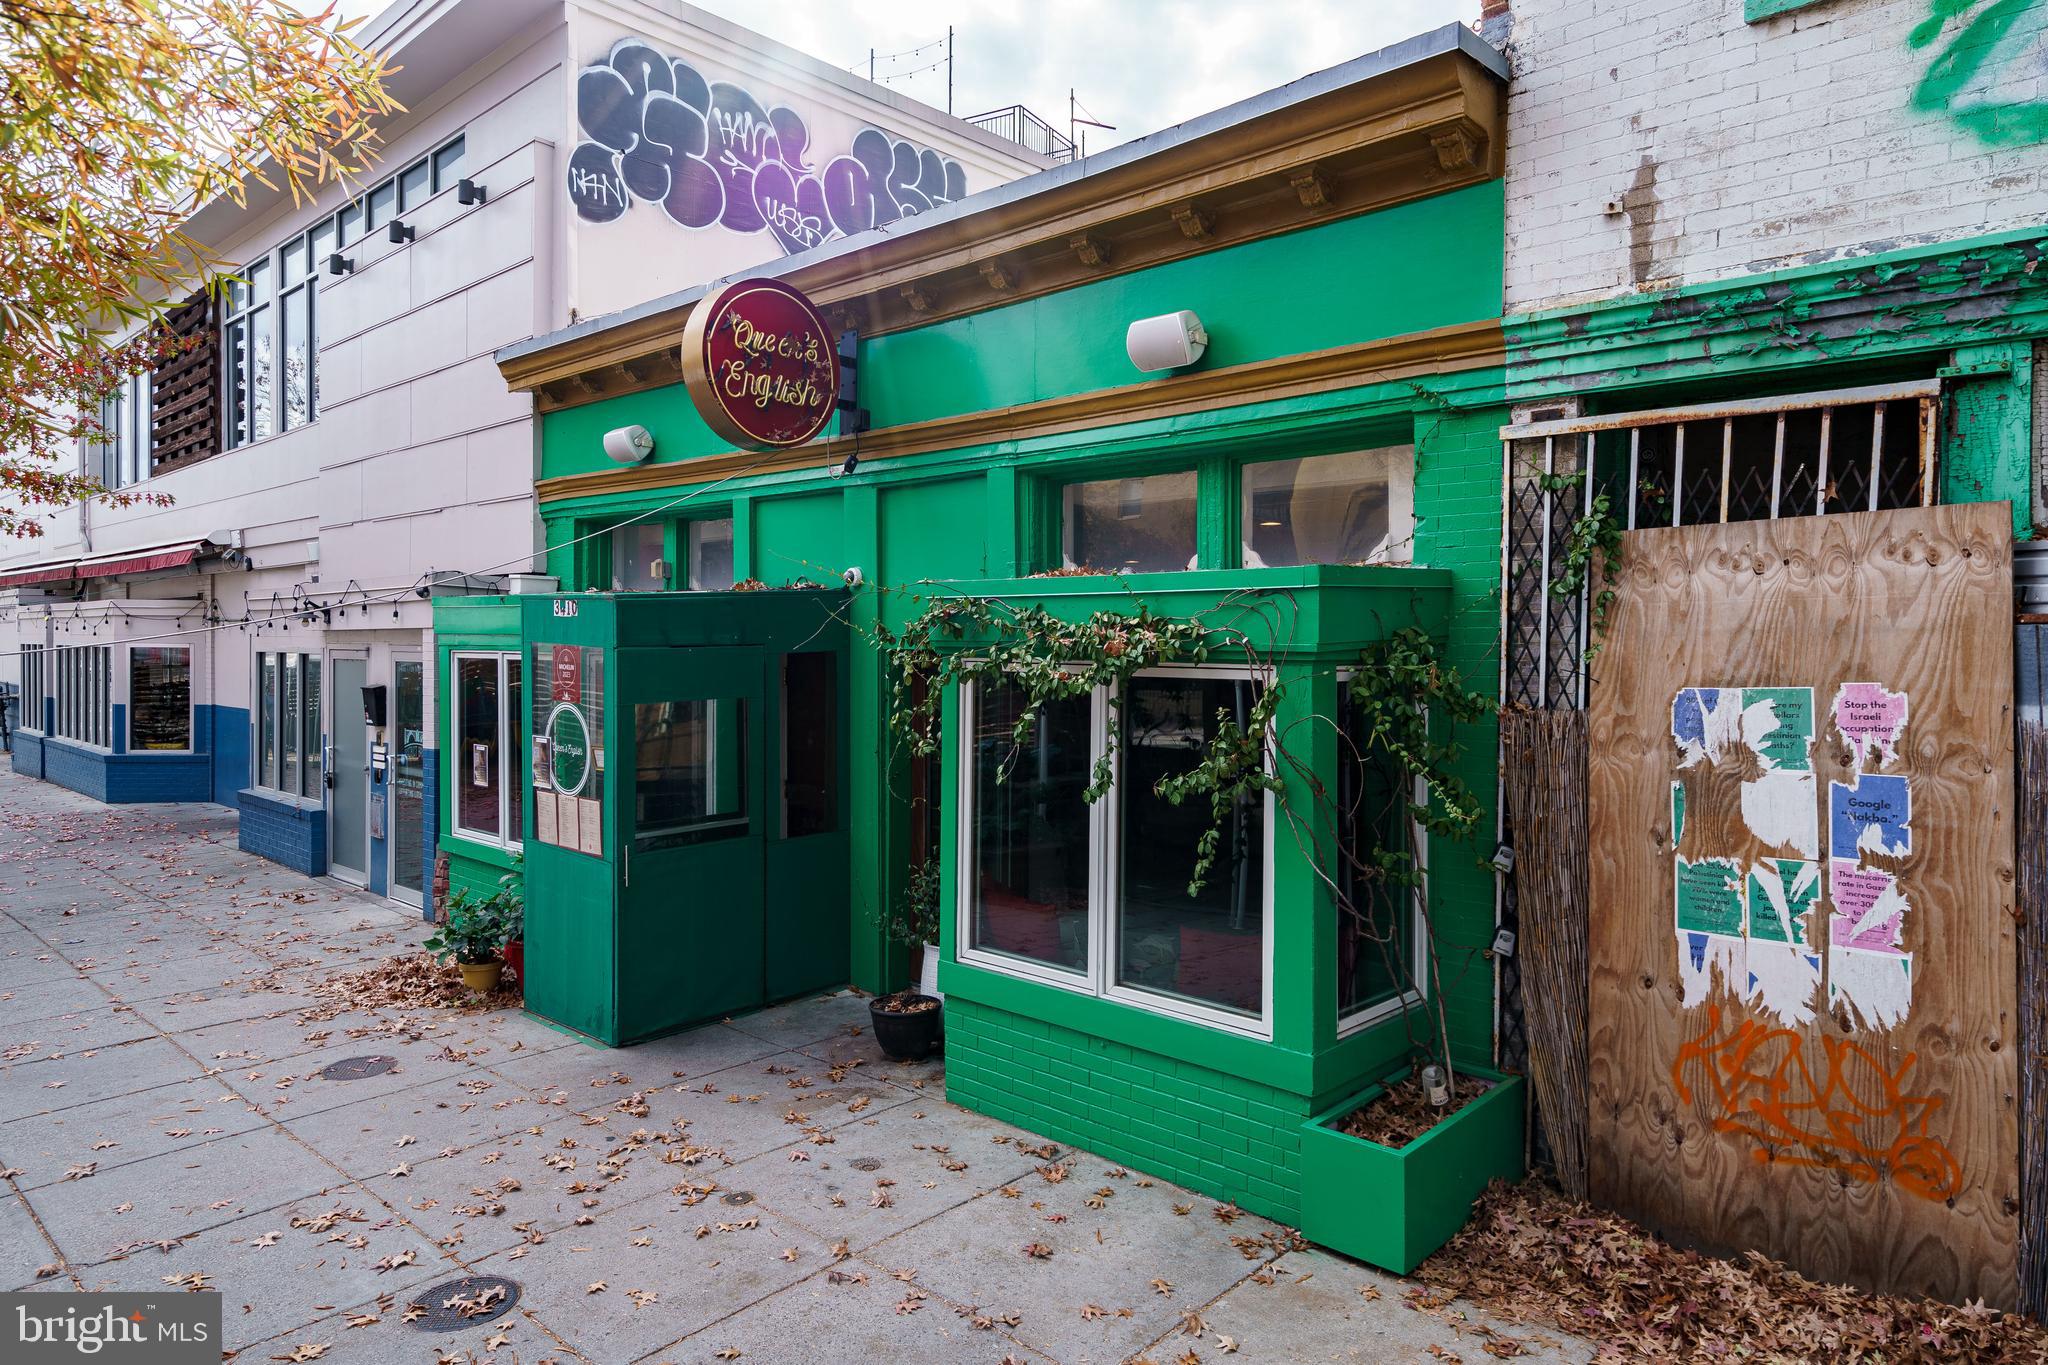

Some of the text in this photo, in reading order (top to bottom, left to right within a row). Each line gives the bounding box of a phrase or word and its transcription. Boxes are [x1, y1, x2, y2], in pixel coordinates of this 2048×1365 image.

[725, 358, 819, 408] English
[1844, 700, 1888, 711] Stop the
[1850, 712, 1882, 721] Israeli
[1848, 797, 1892, 811] Google
[1838, 870, 1853, 879] The
[1837, 880, 1855, 888] rate
